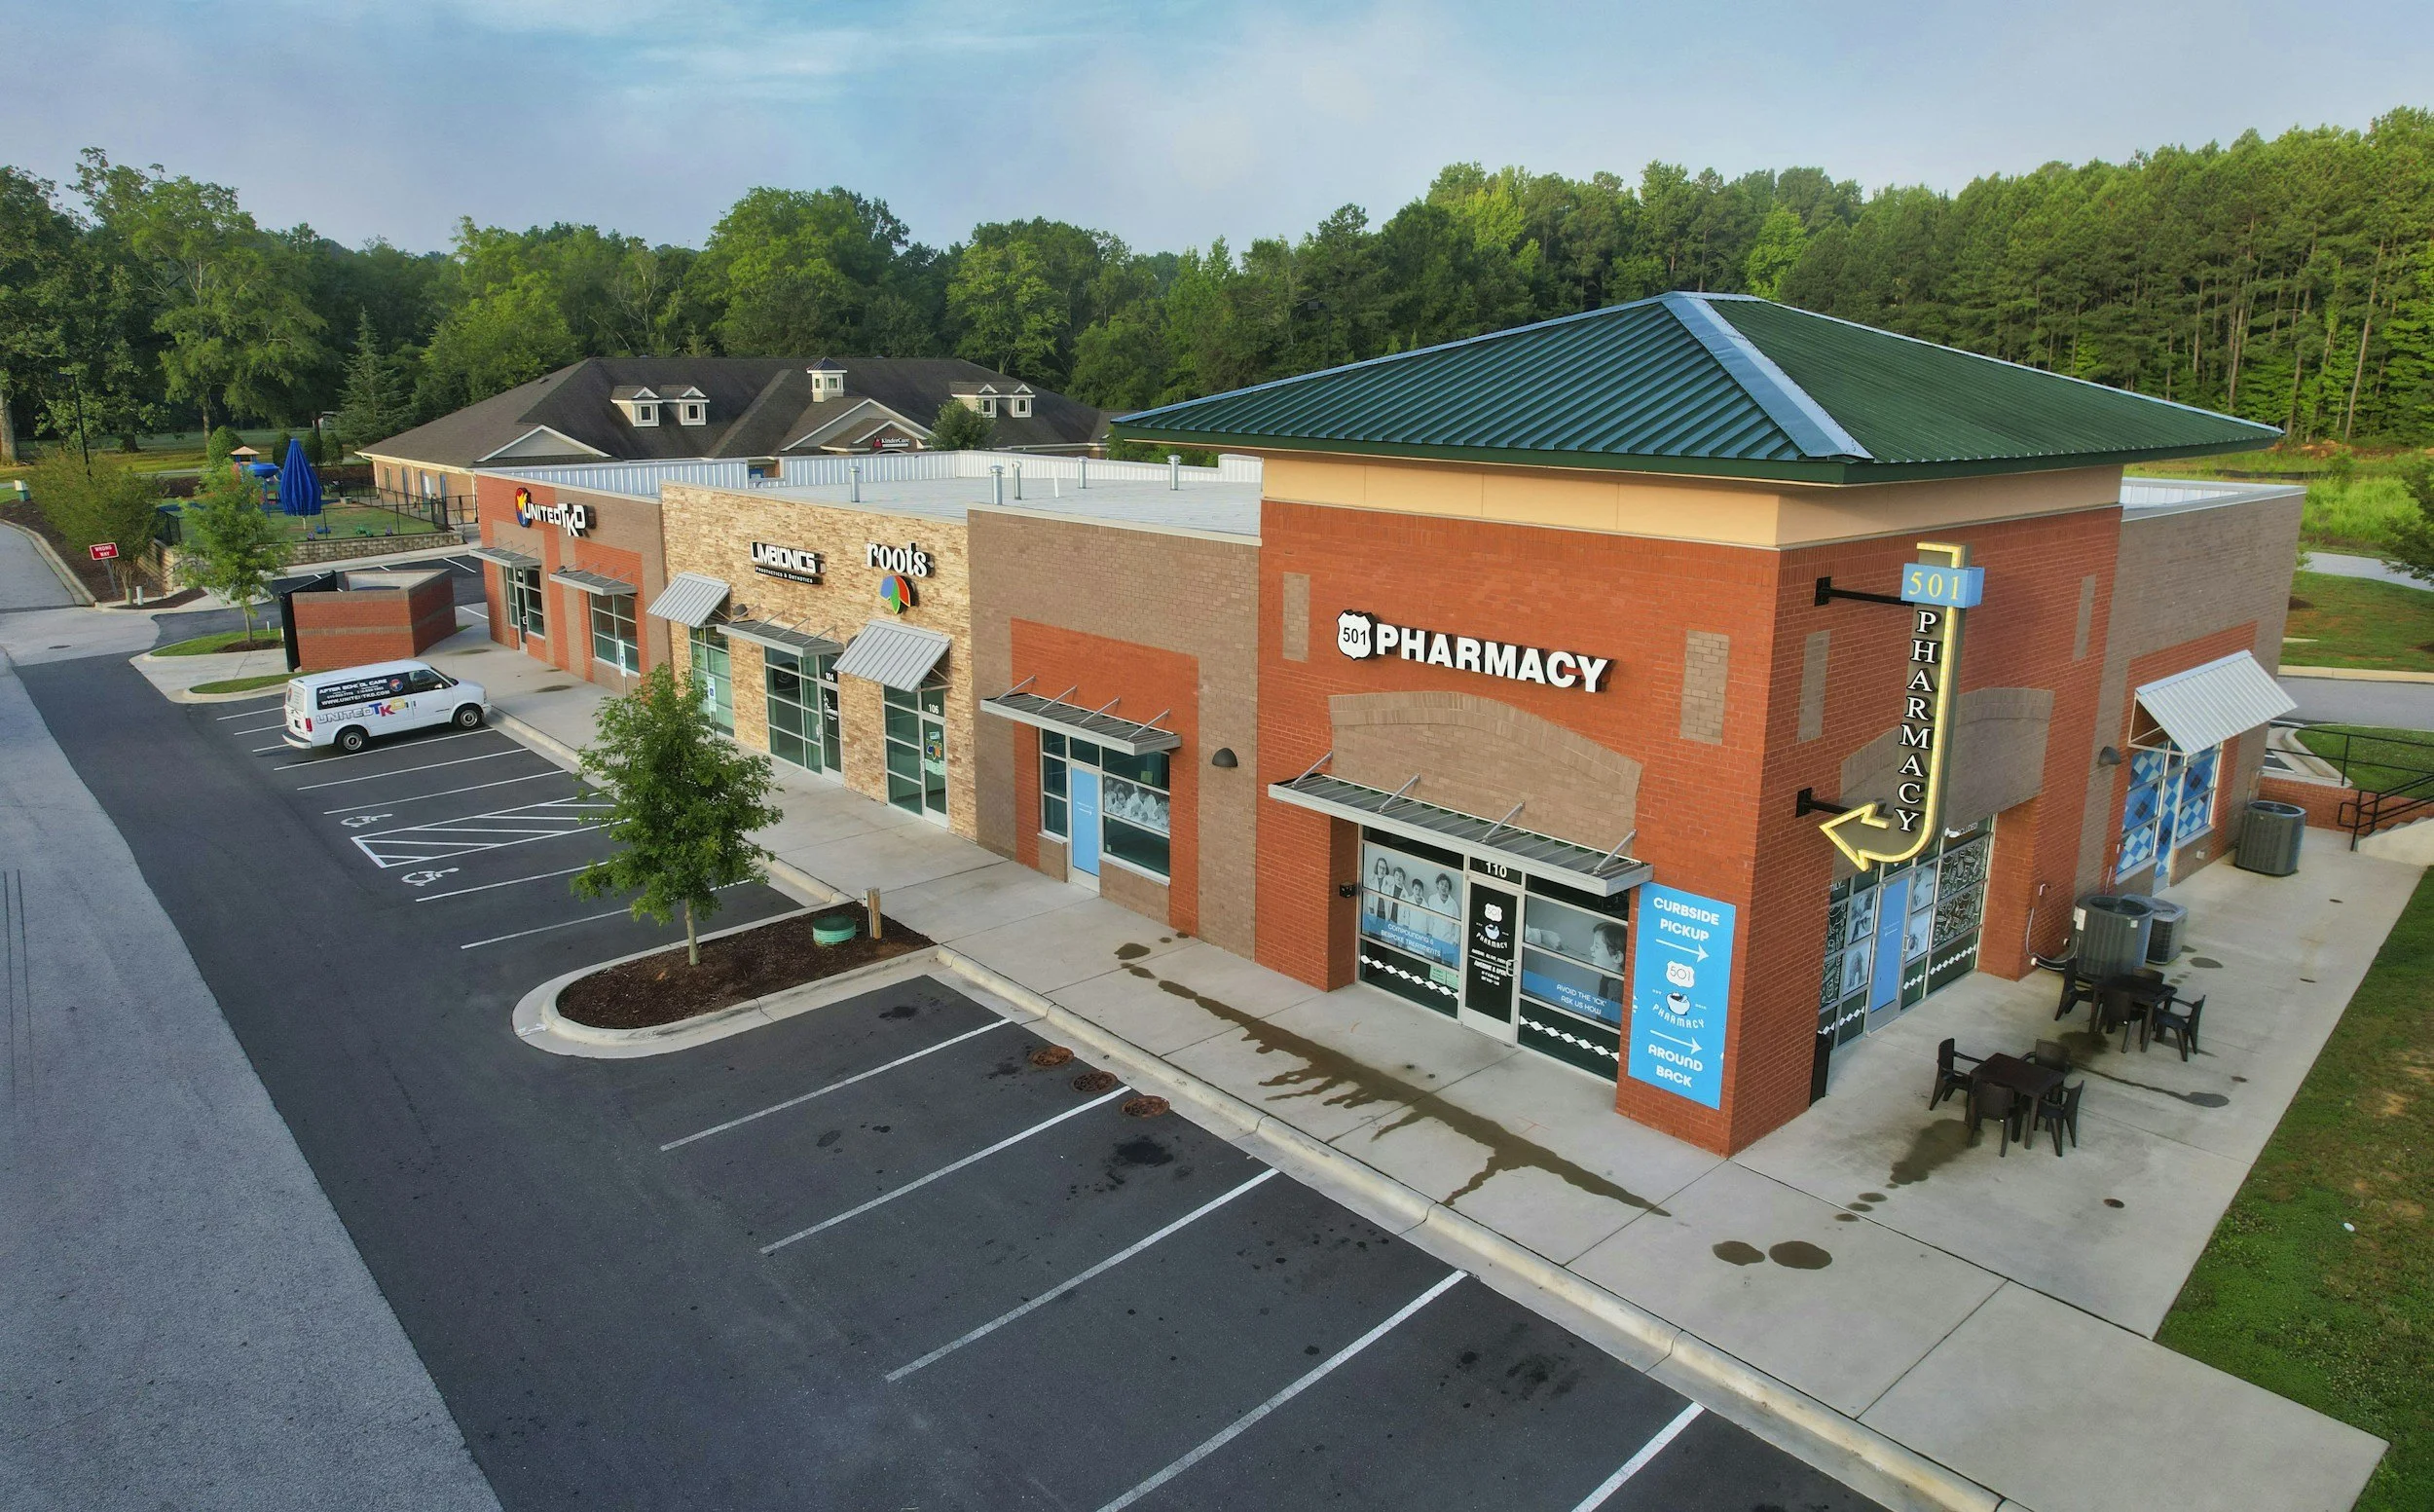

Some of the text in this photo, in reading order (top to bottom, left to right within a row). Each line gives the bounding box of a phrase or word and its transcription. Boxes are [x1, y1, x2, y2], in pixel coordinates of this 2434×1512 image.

[750, 541, 816, 573] LIMBIONICS
[867, 541, 928, 577] roots
[1908, 571, 1959, 601] 501
[1343, 623, 1608, 693] 501 PHARMACY
[928, 703, 940, 714] 106
[1896, 610, 1936, 832] PHARMACY
[1486, 862, 1507, 878] 110
[1653, 897, 1720, 926] CURBSIDE
[1387, 924, 1429, 943] COMPOUNDING
[1476, 932, 1508, 948] PHARMACY
[1660, 918, 1710, 941] PICKUP
[1381, 930, 1441, 957] BESPOKE TREATMENTS
[1670, 965, 1691, 981] 501
[1557, 983, 1577, 996] AVOID
[1578, 991, 1591, 1001] THE
[1561, 995, 1602, 1015] ASK US HOW
[1652, 1003, 1705, 1029] PHARMACY
[1647, 1044, 1703, 1072] AROUND
[1655, 1064, 1692, 1088] BACK
